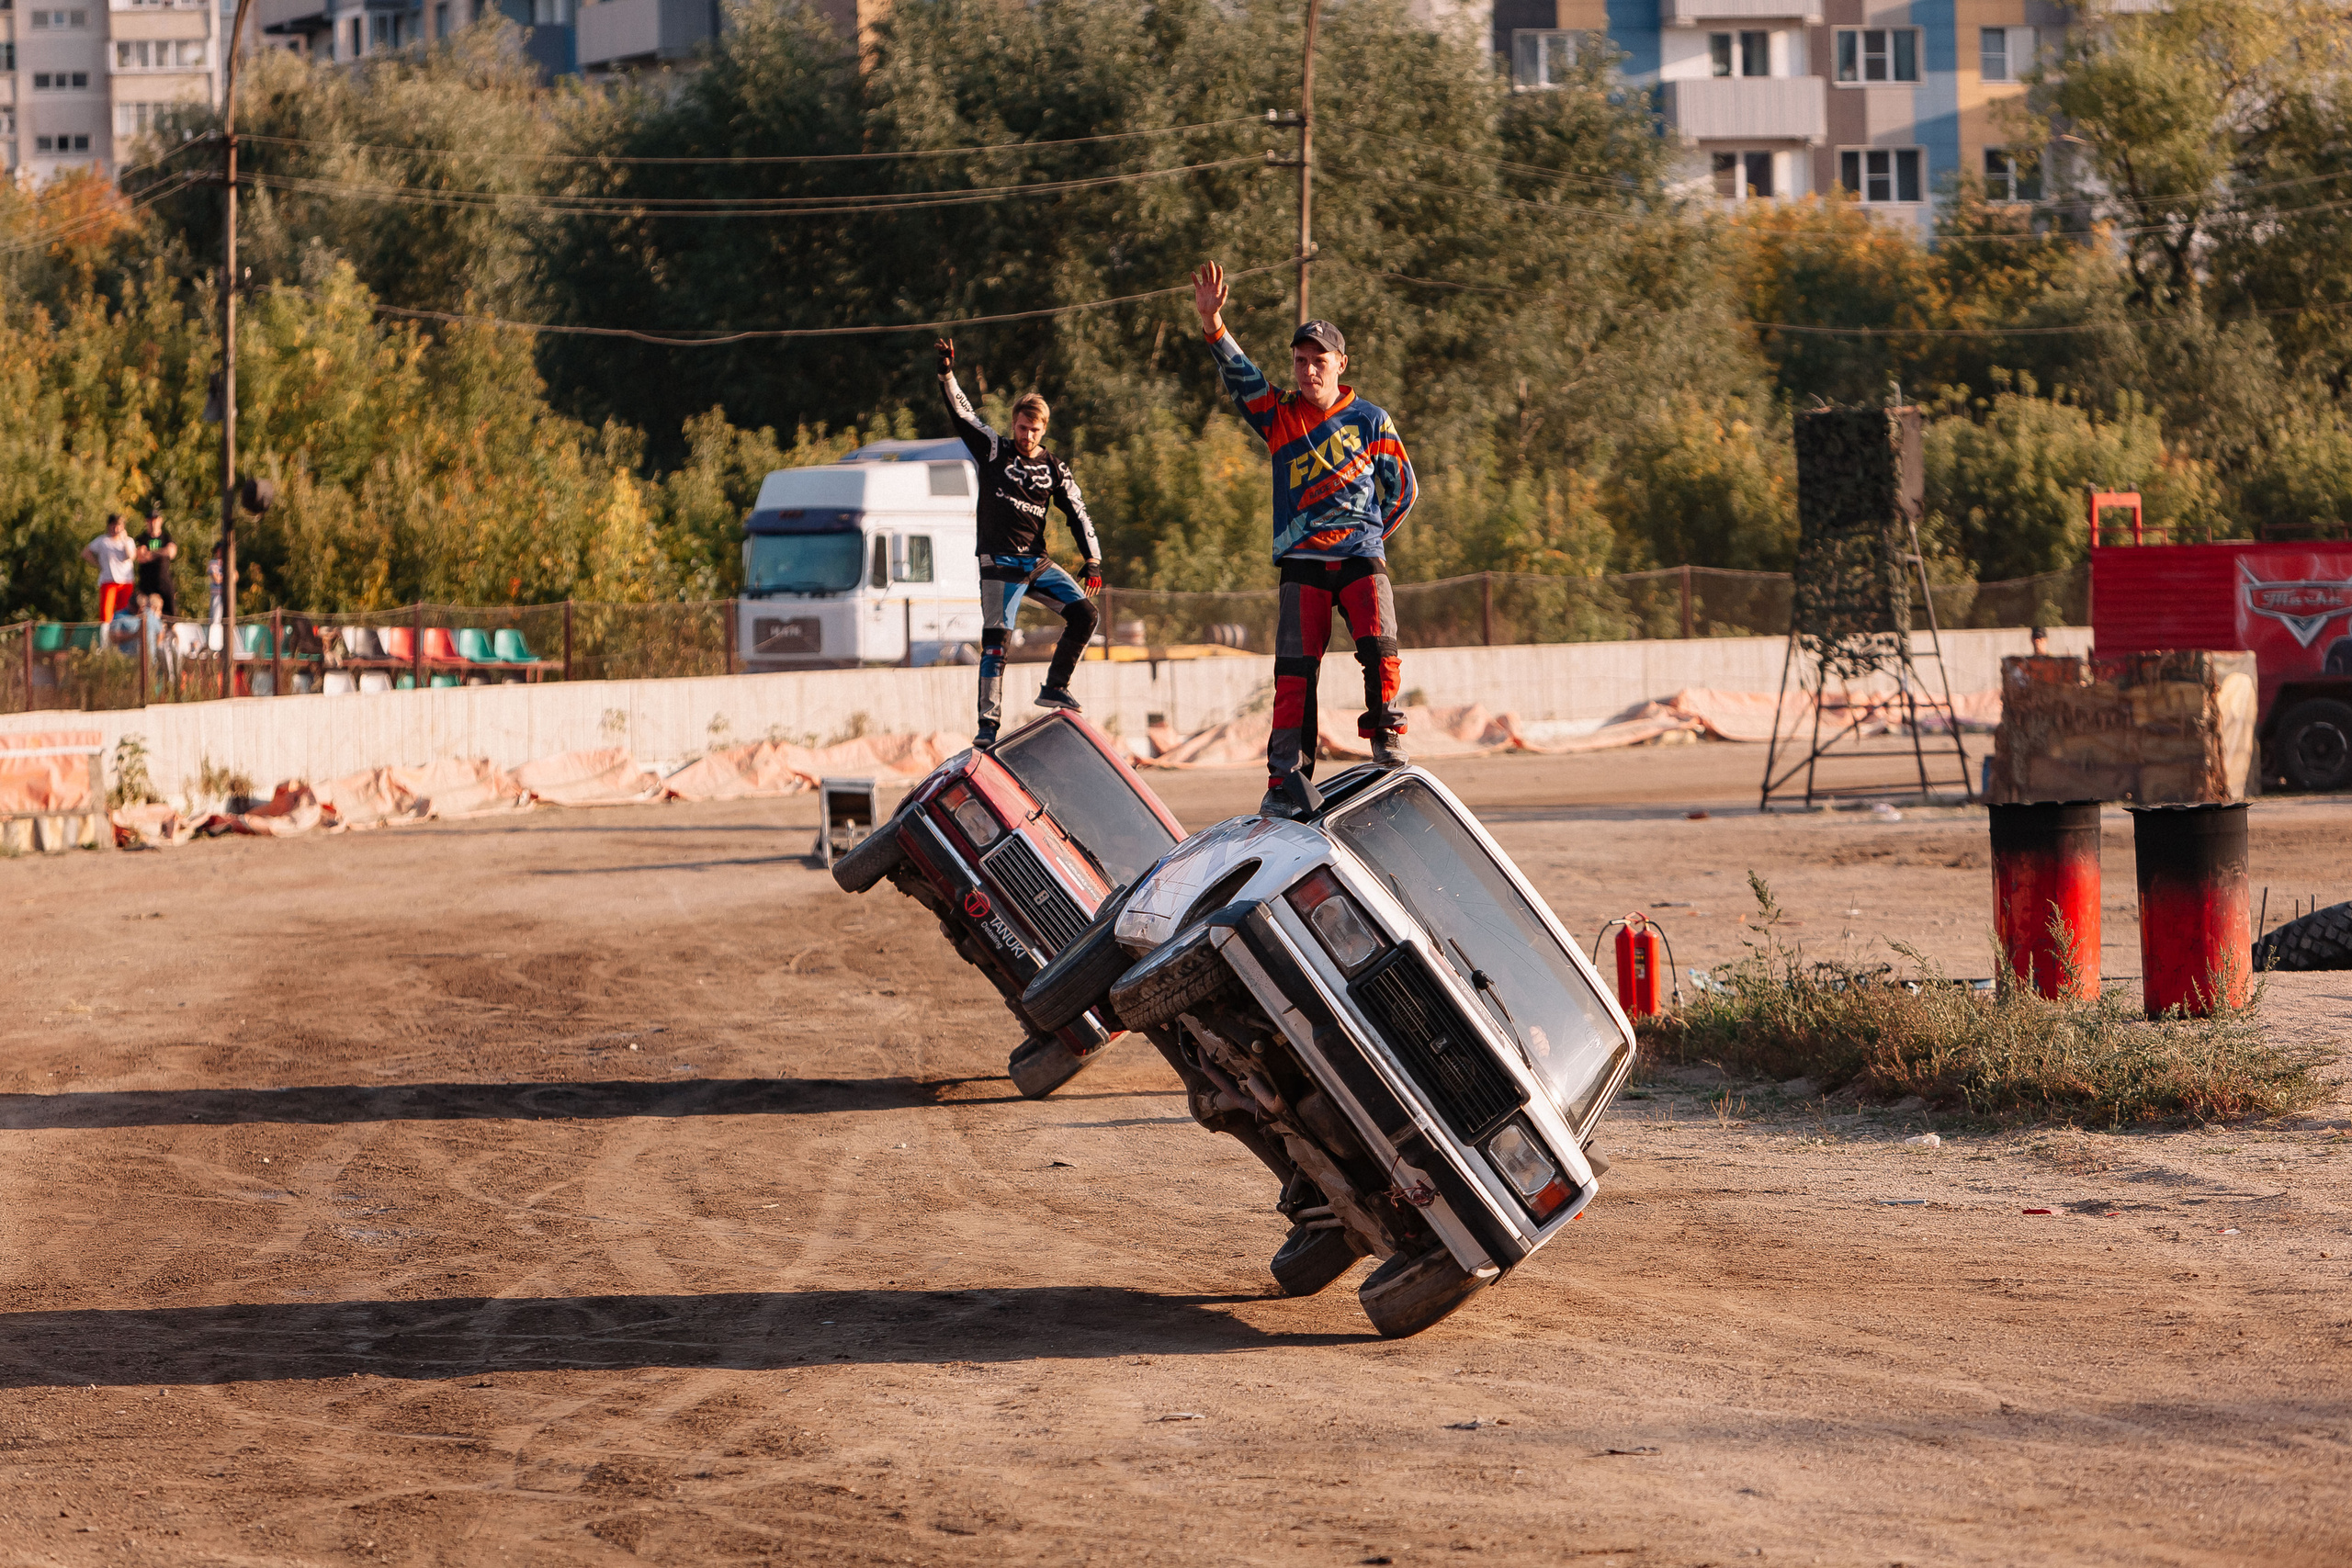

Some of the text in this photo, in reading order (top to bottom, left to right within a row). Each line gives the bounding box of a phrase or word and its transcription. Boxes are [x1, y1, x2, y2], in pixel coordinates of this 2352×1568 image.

[1284, 424, 1362, 490] FXR
[995, 487, 1046, 518] Sreme
[1308, 482, 1332, 500] RACE
[979, 920, 1003, 951] Detailing
[989, 916, 1027, 960] TANUKI
